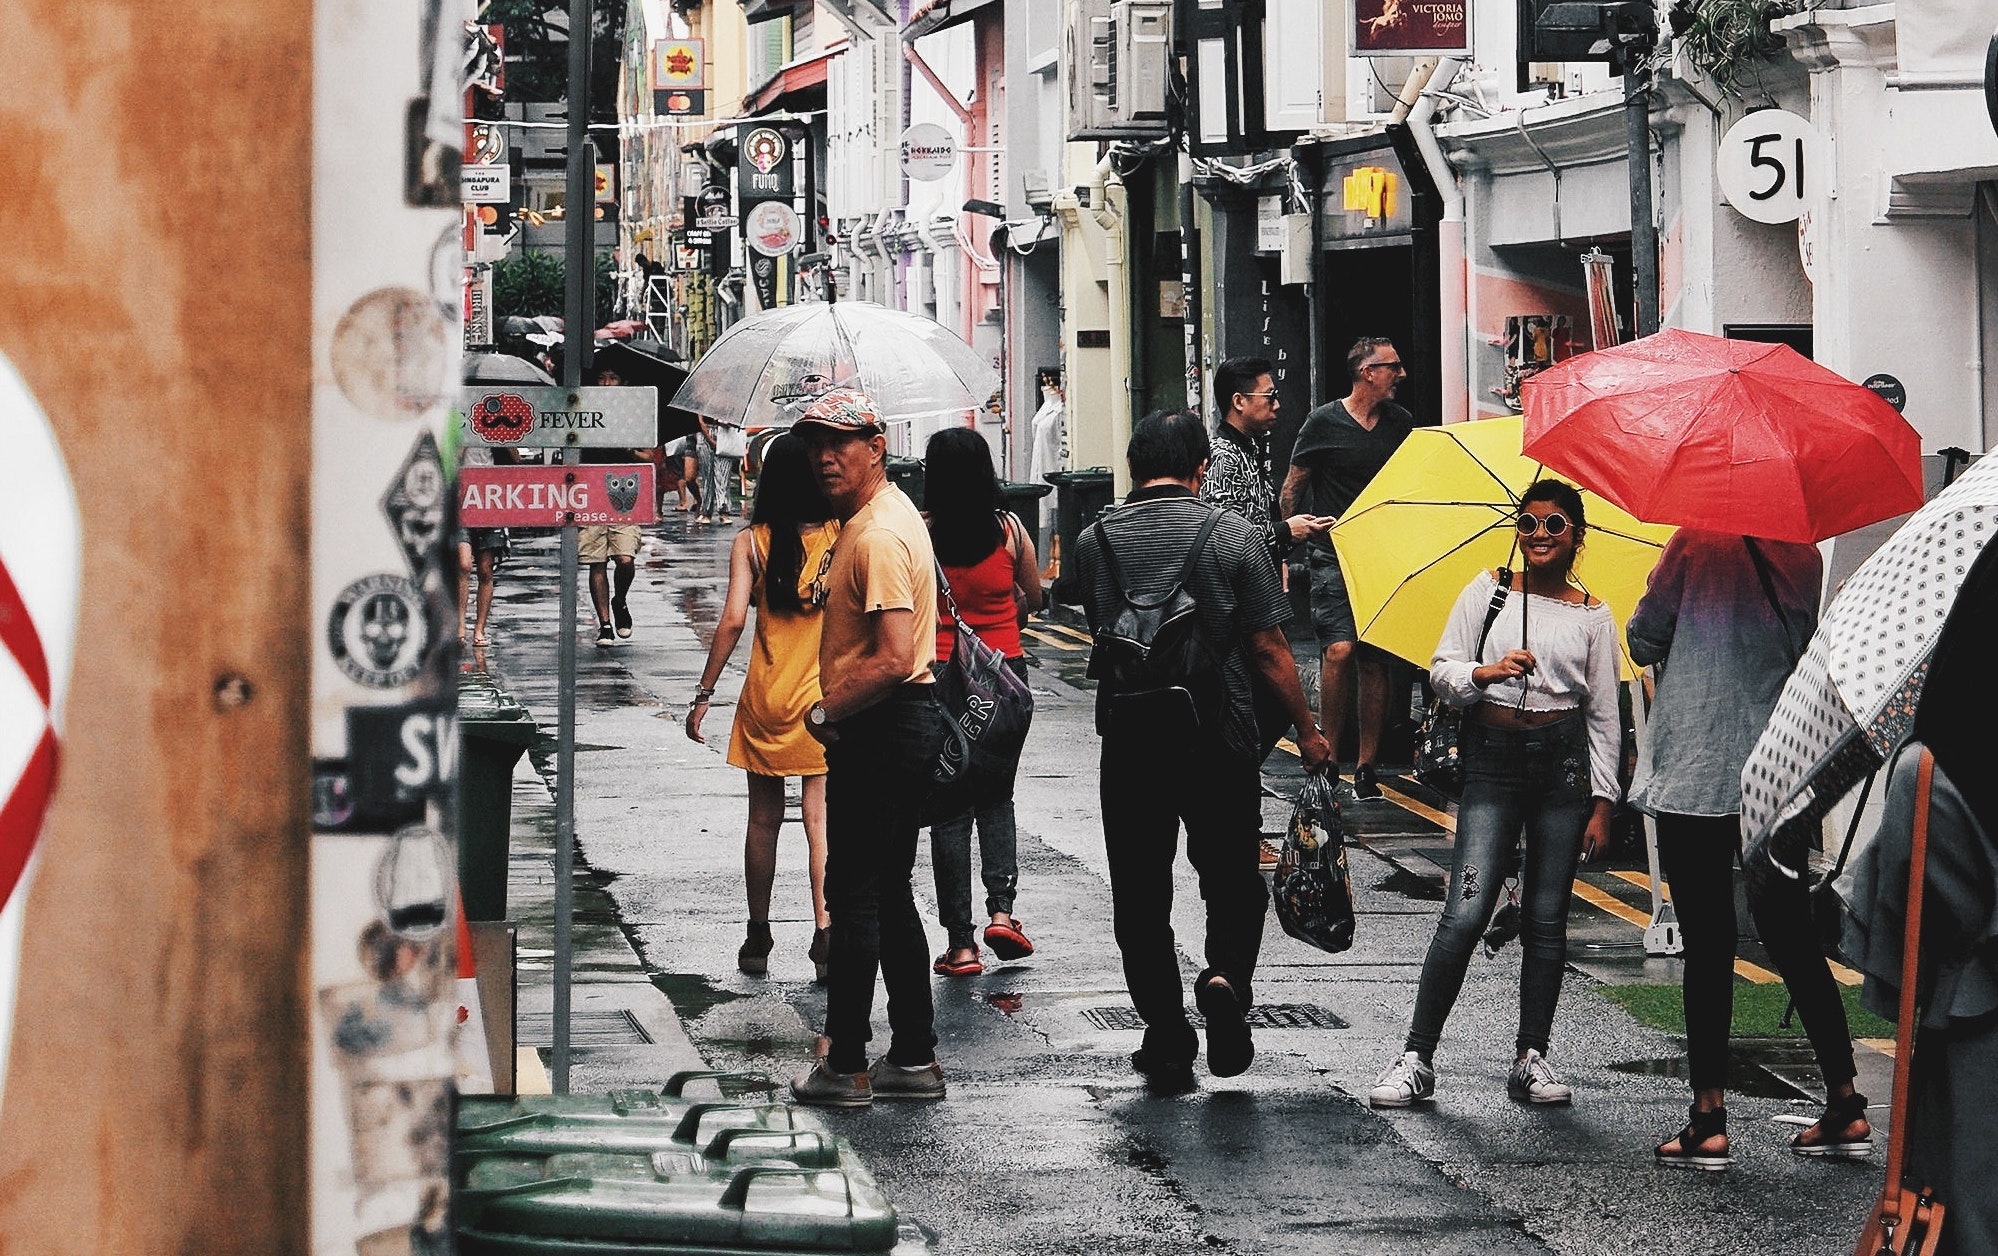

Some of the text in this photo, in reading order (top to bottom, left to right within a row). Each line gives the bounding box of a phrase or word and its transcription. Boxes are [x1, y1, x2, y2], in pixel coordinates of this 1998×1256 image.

[1412, 4, 1463, 13] VICTORIA
[1433, 12, 1463, 23] JOMO
[1743, 133, 1804, 200] 51
[539, 411, 606, 429] FEVER
[462, 483, 589, 510] ARKING
[555, 510, 632, 522] Pease...
